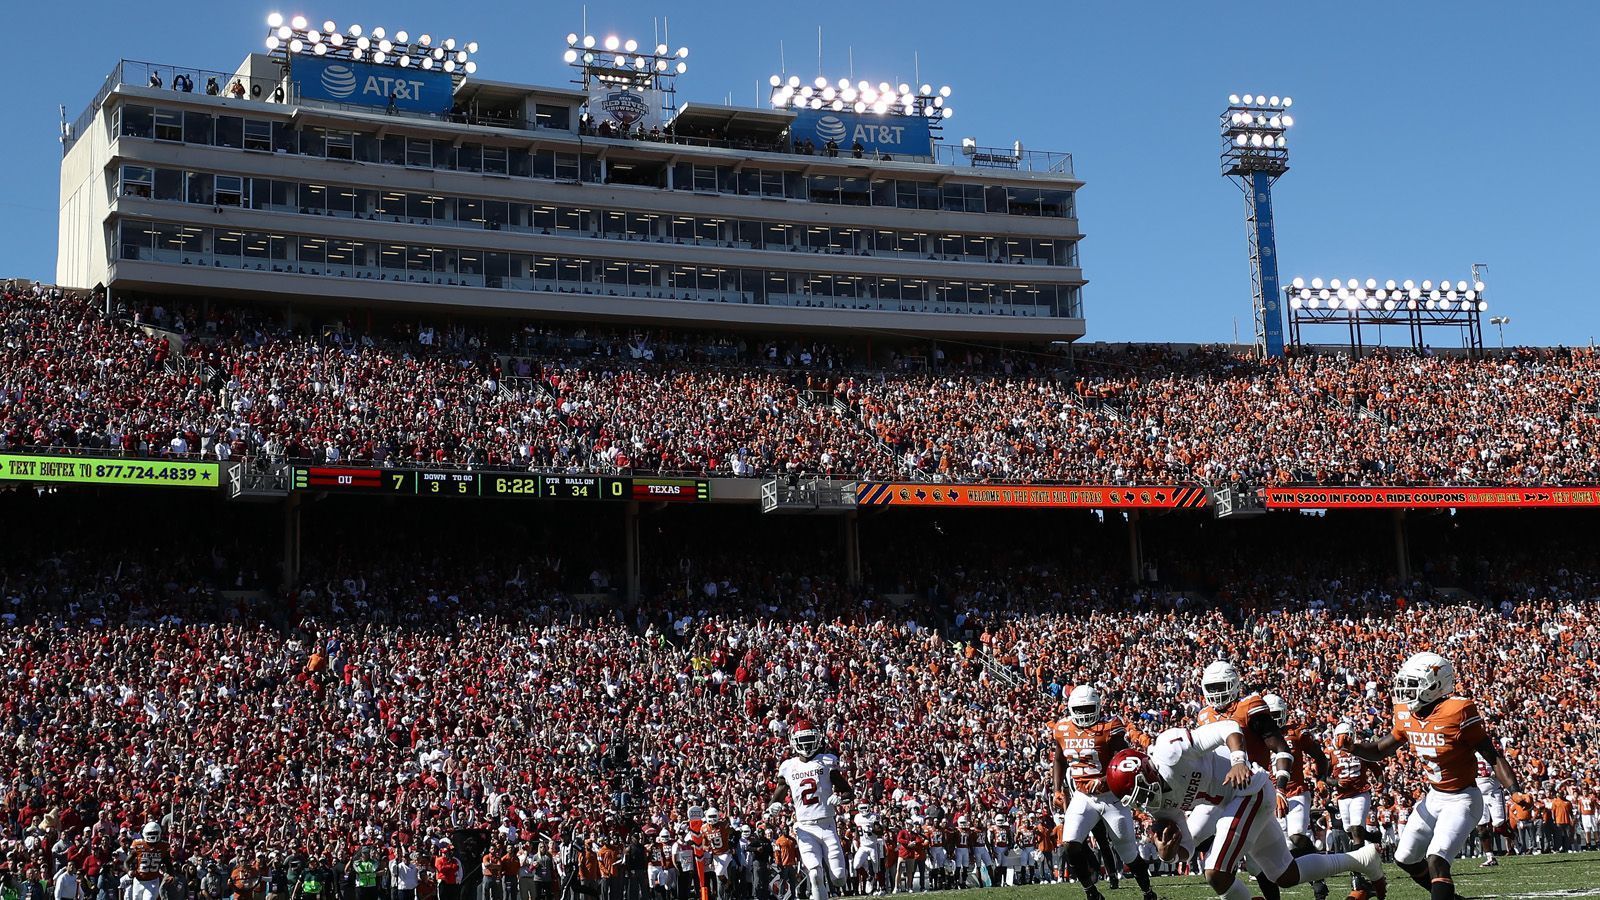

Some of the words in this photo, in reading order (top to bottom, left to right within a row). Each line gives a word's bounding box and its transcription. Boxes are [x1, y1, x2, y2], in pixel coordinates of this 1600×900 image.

[362, 75, 425, 101] AT&T
[603, 100, 620, 109] RED
[621, 100, 648, 113] RIVER
[606, 106, 645, 115] SHOWDOWN
[852, 123, 905, 145] AT&T
[9, 460, 36, 475] TEXT
[39, 461, 75, 477] BIGTEX
[79, 463, 92, 478] TO
[95, 465, 197, 480] 877.724.4839
[338, 475, 353, 484] OU
[392, 474, 404, 490] 7
[424, 473, 447, 481] DOWN
[431, 481, 439, 493] 3
[458, 482, 467, 493] 5
[496, 478, 535, 494] 6:22
[549, 485, 557, 496] 1
[571, 486, 588, 496] 34
[612, 482, 622, 496] 0
[648, 485, 680, 494] TEXAS
[967, 490, 1000, 502] WELCOME
[1003, 490, 1012, 503] TO
[1014, 490, 1028, 503] THE
[1030, 490, 1050, 503] STATE
[1052, 491, 1068, 503] FAIR
[1070, 491, 1078, 503] OF
[1081, 491, 1102, 503] TEXAS
[1271, 494, 1295, 503] WIN
[1297, 494, 1327, 503] $200
[1330, 494, 1340, 503] IN
[1343, 494, 1373, 503] FOOD
[1376, 494, 1384, 503] &
[1386, 494, 1412, 502] RIDE
[1414, 493, 1466, 502] COUPONS
[1064, 738, 1095, 749] TEXAS
[1406, 731, 1446, 747] TEXAS
[1415, 746, 1443, 783] 5
[791, 768, 824, 780] SOONERS
[799, 778, 819, 805] 2
[139, 858, 162, 873] 25
